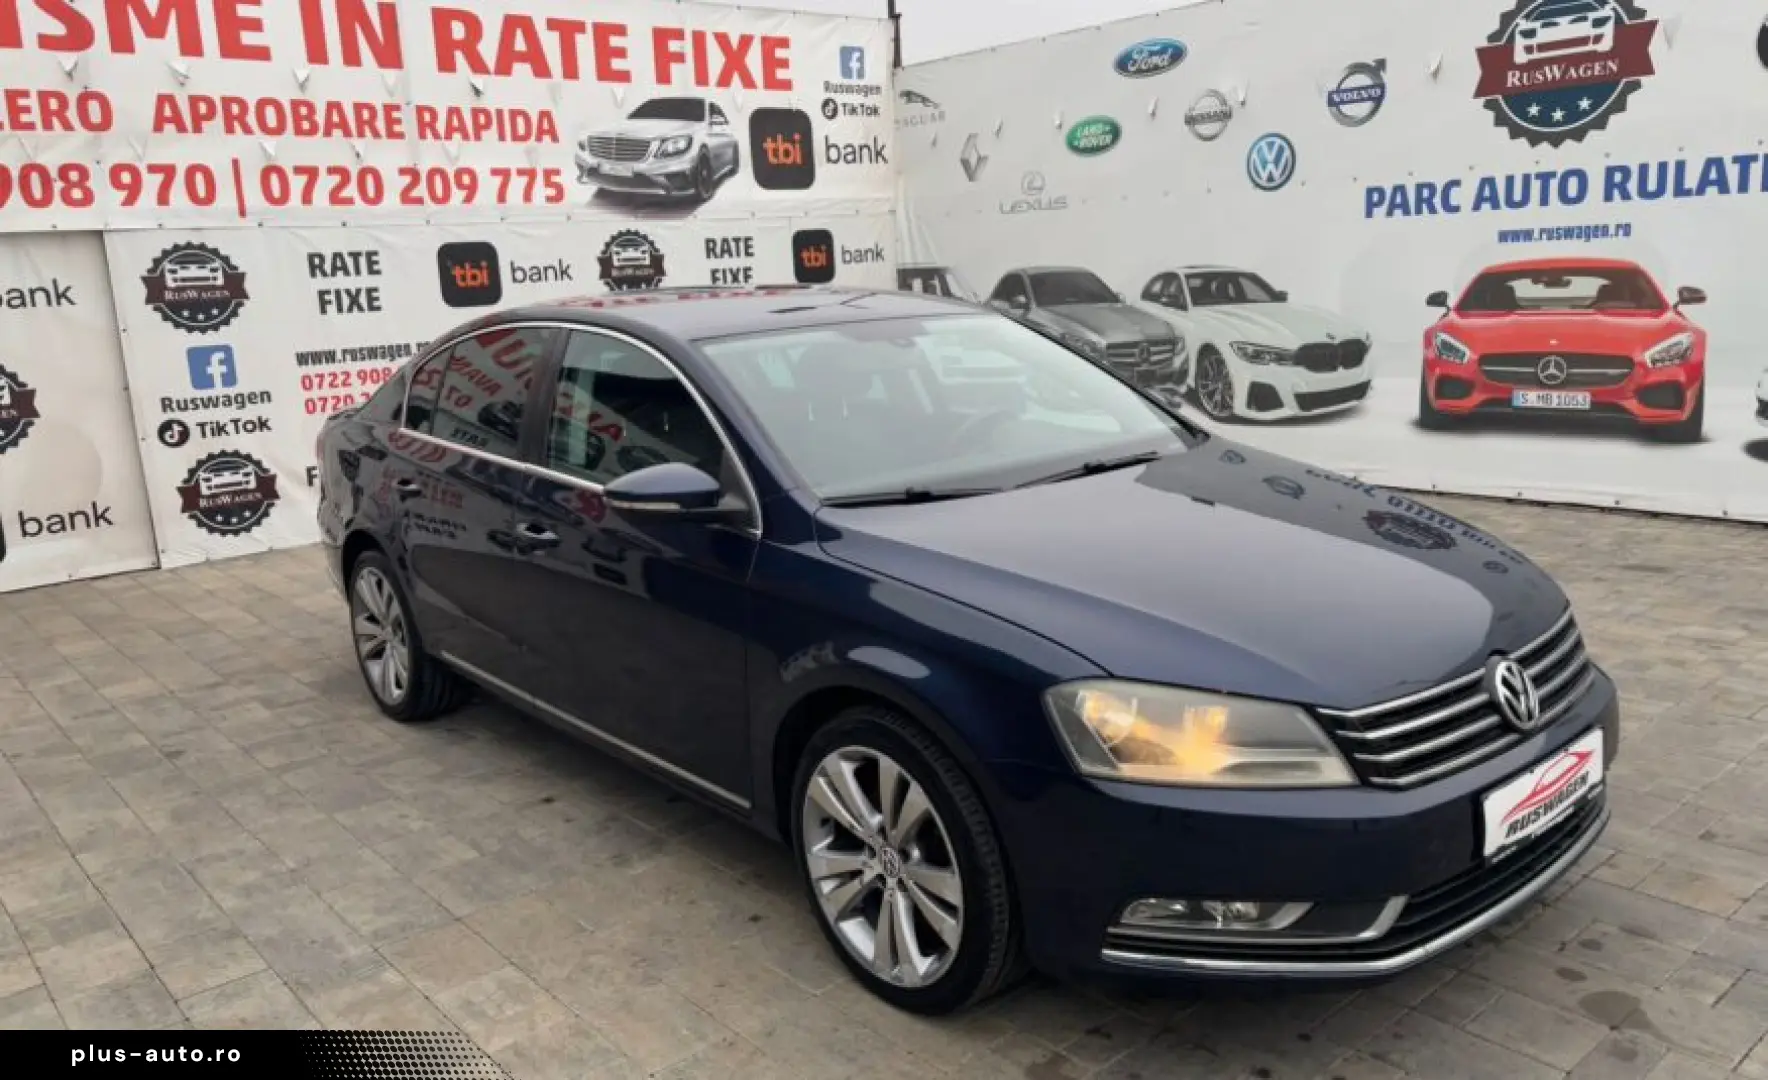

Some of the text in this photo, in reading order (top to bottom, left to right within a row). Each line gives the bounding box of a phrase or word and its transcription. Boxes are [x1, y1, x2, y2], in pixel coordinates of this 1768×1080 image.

[299, 0, 403, 69] IN
[431, 7, 632, 83] RATE
[652, 26, 793, 91] FIXE
[1127, 48, 1173, 72] Ford
[0, 88, 559, 144] ERO APROBARE RAPIDA
[763, 132, 888, 164] tbi bank
[108, 162, 217, 207] 970
[260, 165, 384, 206] 0720
[398, 166, 478, 206] 209
[490, 168, 564, 204] 775
[1364, 179, 1462, 218] PARC
[1471, 168, 1588, 211] AUTO
[1000, 196, 1068, 214] LEXUS
[704, 236, 755, 259] RATE
[1497, 222, 1631, 243] www.ruswagen.ro
[307, 249, 382, 279] RATE
[801, 243, 884, 267] tbi bank
[453, 259, 573, 288] tbi bank
[0, 278, 76, 309] ank
[317, 285, 382, 316] FIXE
[300, 371, 352, 391] 0722
[160, 391, 272, 413] Ruswagen
[196, 416, 272, 438] TikTok
[18, 501, 113, 538] bank
[1505, 770, 1589, 839] RUSWAGEN
